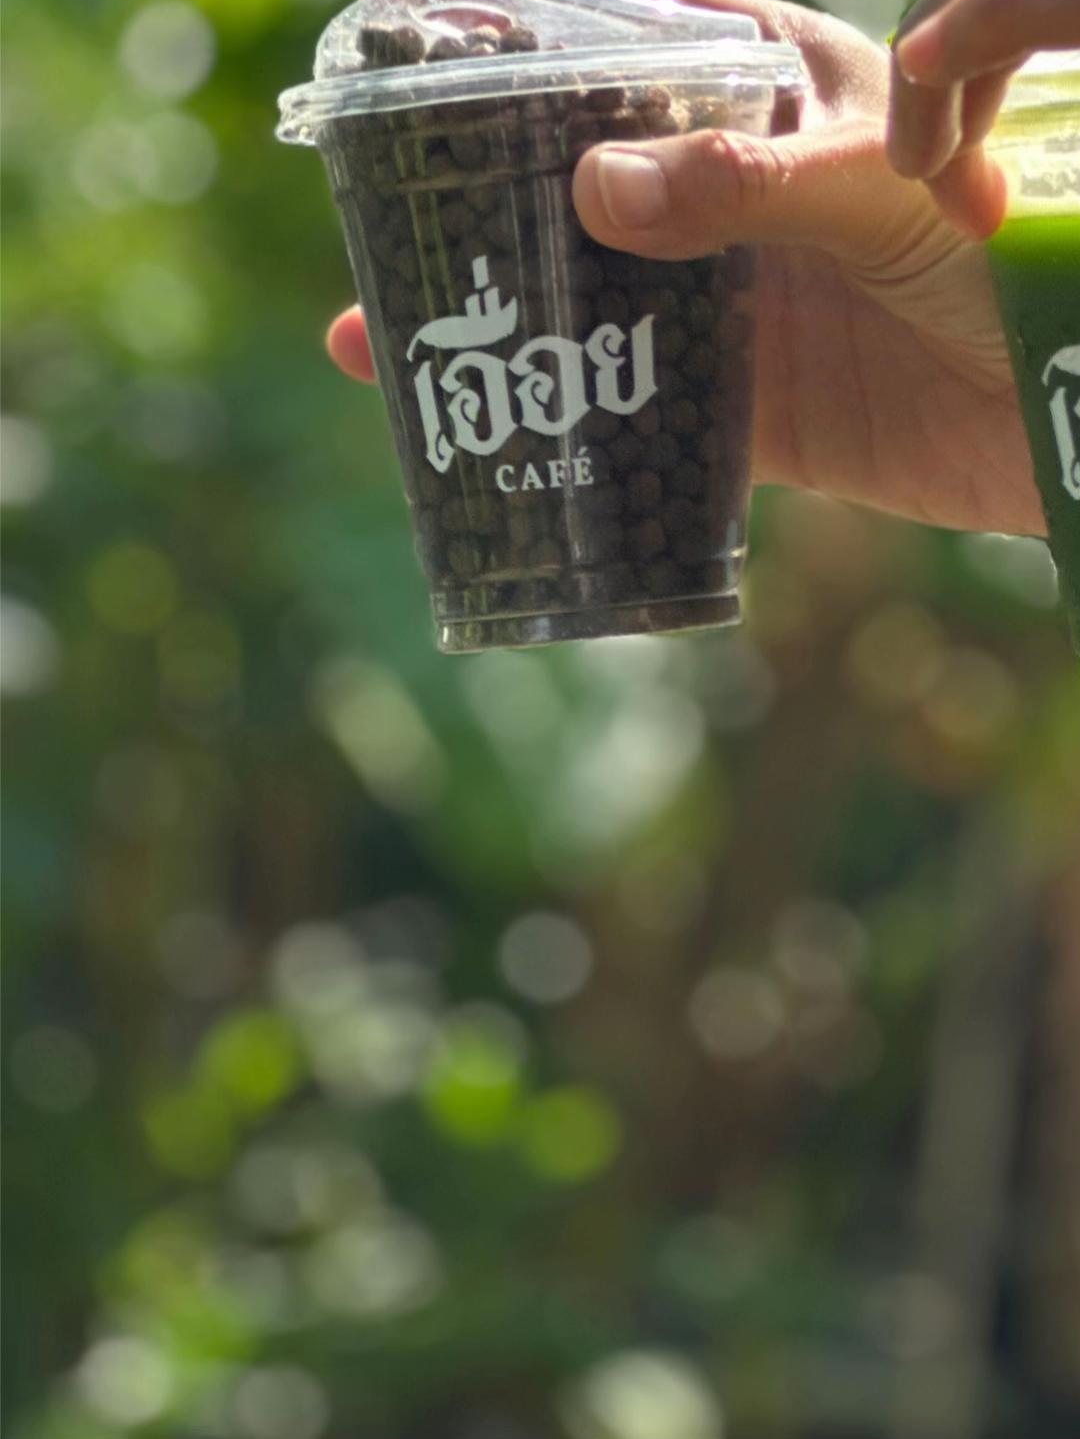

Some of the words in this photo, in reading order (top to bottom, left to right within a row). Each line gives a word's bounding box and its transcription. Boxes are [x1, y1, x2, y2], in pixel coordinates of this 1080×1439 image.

[406, 255, 658, 474] เอื่อย
[495, 446, 594, 493] CAFÉ
